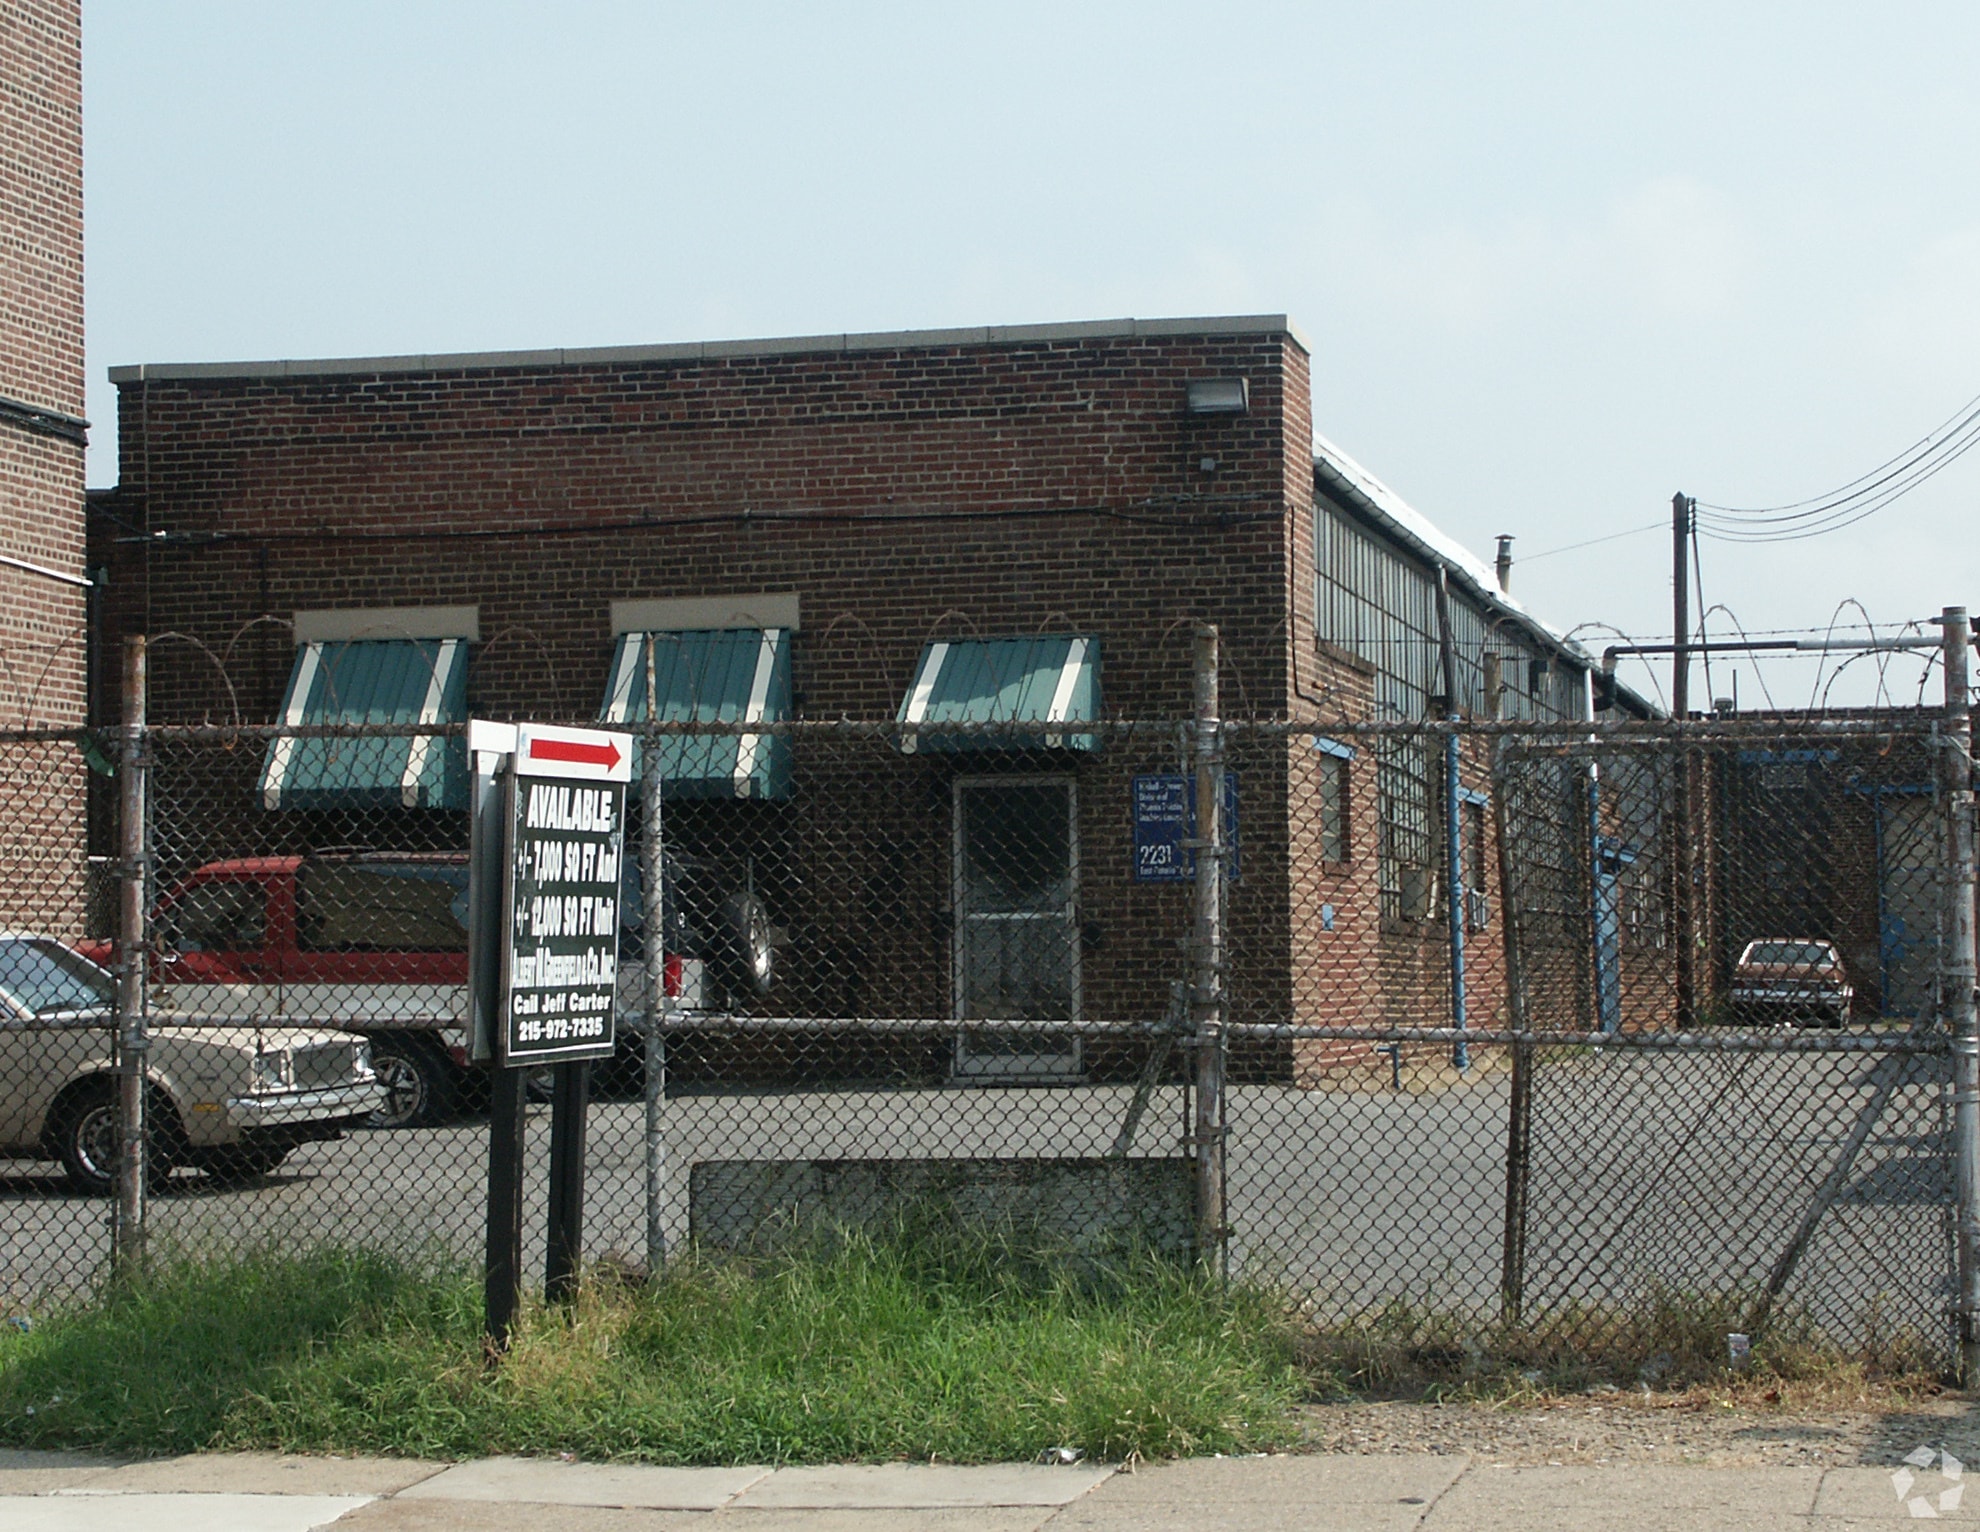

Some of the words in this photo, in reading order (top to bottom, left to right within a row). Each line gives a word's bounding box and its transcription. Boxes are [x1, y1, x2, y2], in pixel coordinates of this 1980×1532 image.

[527, 784, 613, 832] AVAILABLE
[534, 840, 563, 890] 7,000
[564, 841, 580, 882] SQ
[582, 843, 596, 882] FT
[597, 844, 618, 883] And
[1140, 844, 1172, 865] 2231
[531, 896, 562, 945] 12,000
[563, 896, 578, 936] SQ
[579, 896, 593, 935] FT
[514, 994, 539, 1015] Call
[542, 993, 566, 1013] Jeff
[569, 992, 611, 1012] Carter
[519, 1016, 604, 1041] 215-972-7335
